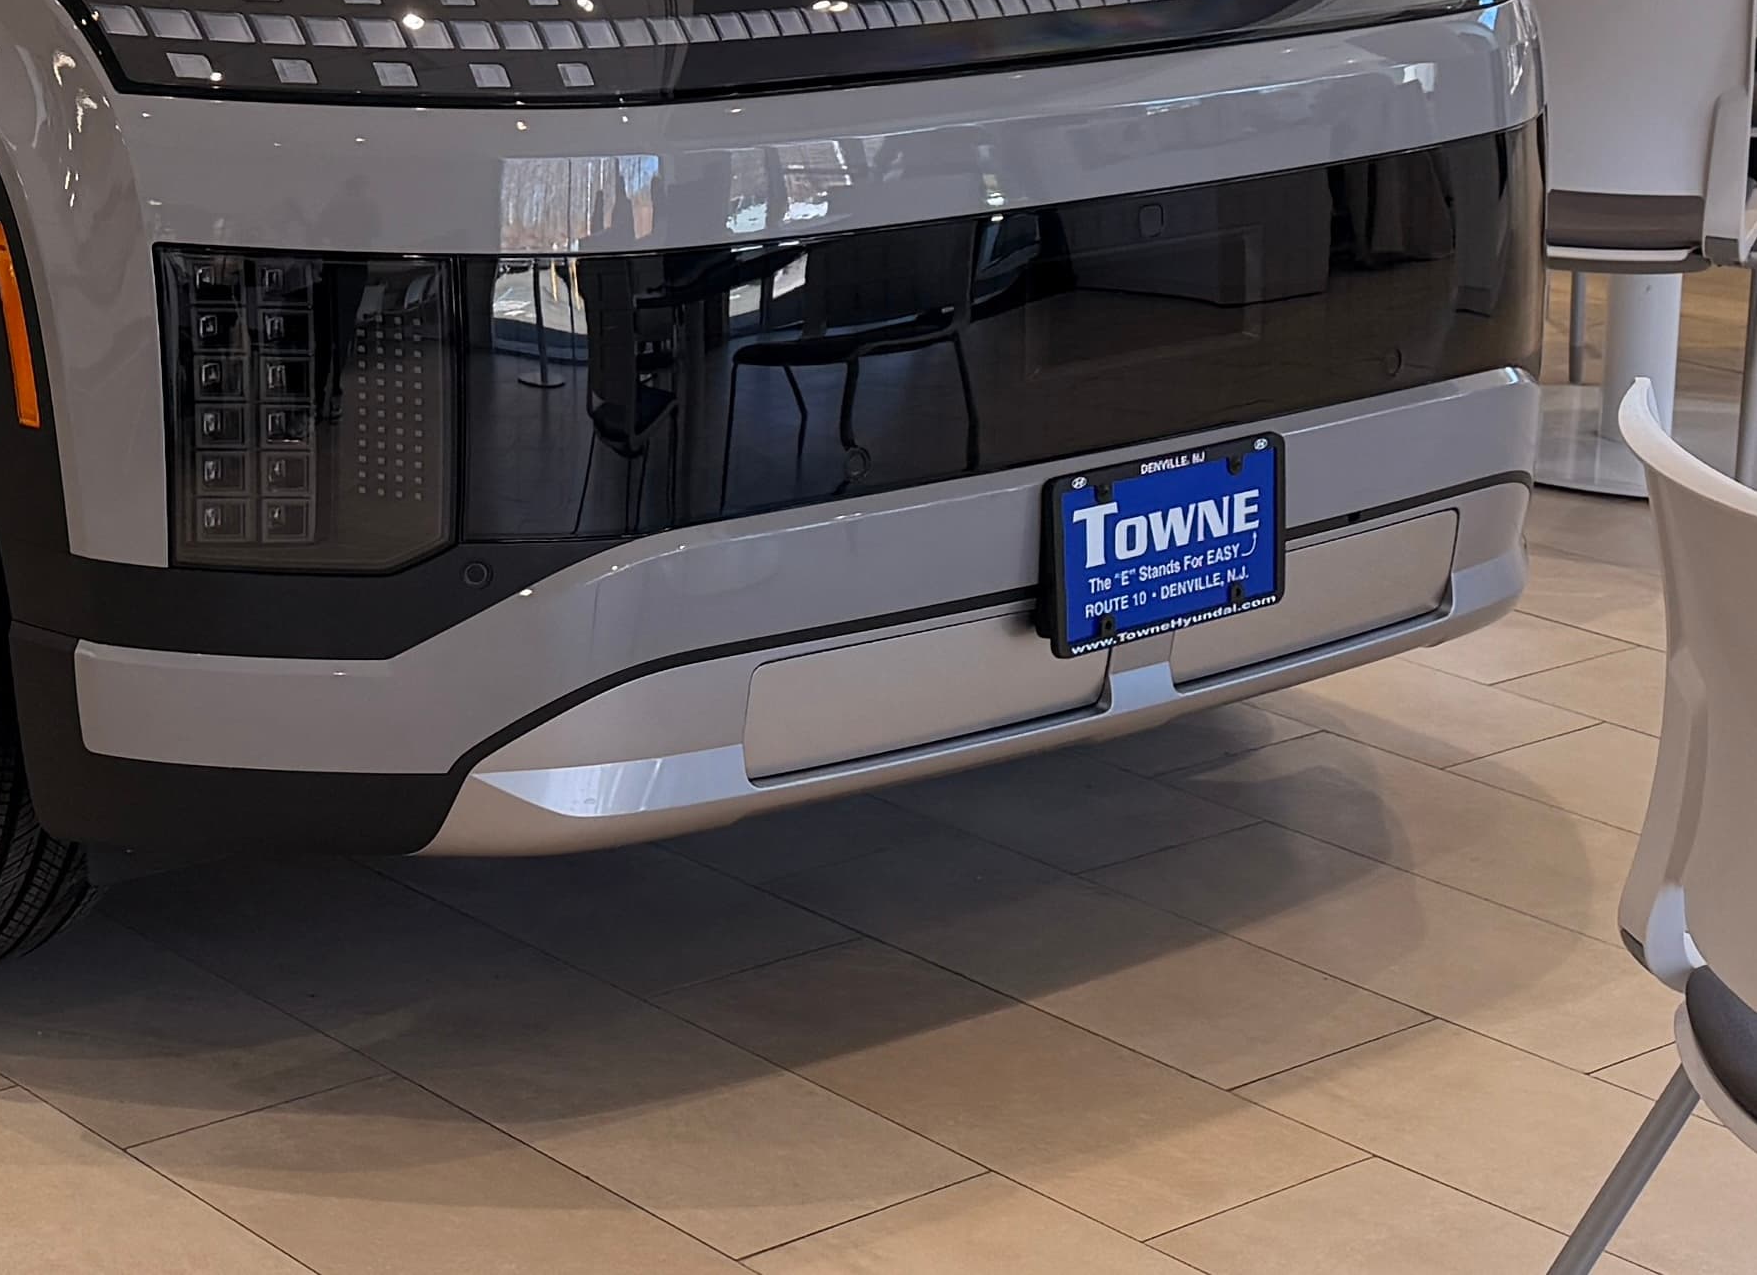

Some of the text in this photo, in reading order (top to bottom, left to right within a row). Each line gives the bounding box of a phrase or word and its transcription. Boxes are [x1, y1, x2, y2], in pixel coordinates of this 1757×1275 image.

[1192, 451, 1206, 464] NJ
[1073, 489, 1260, 569] TOWNE
[1085, 566, 1250, 619] ROUTE 10 DENVILLE, N.J.
[1088, 543, 1241, 594] The "E" Stands For EASY
